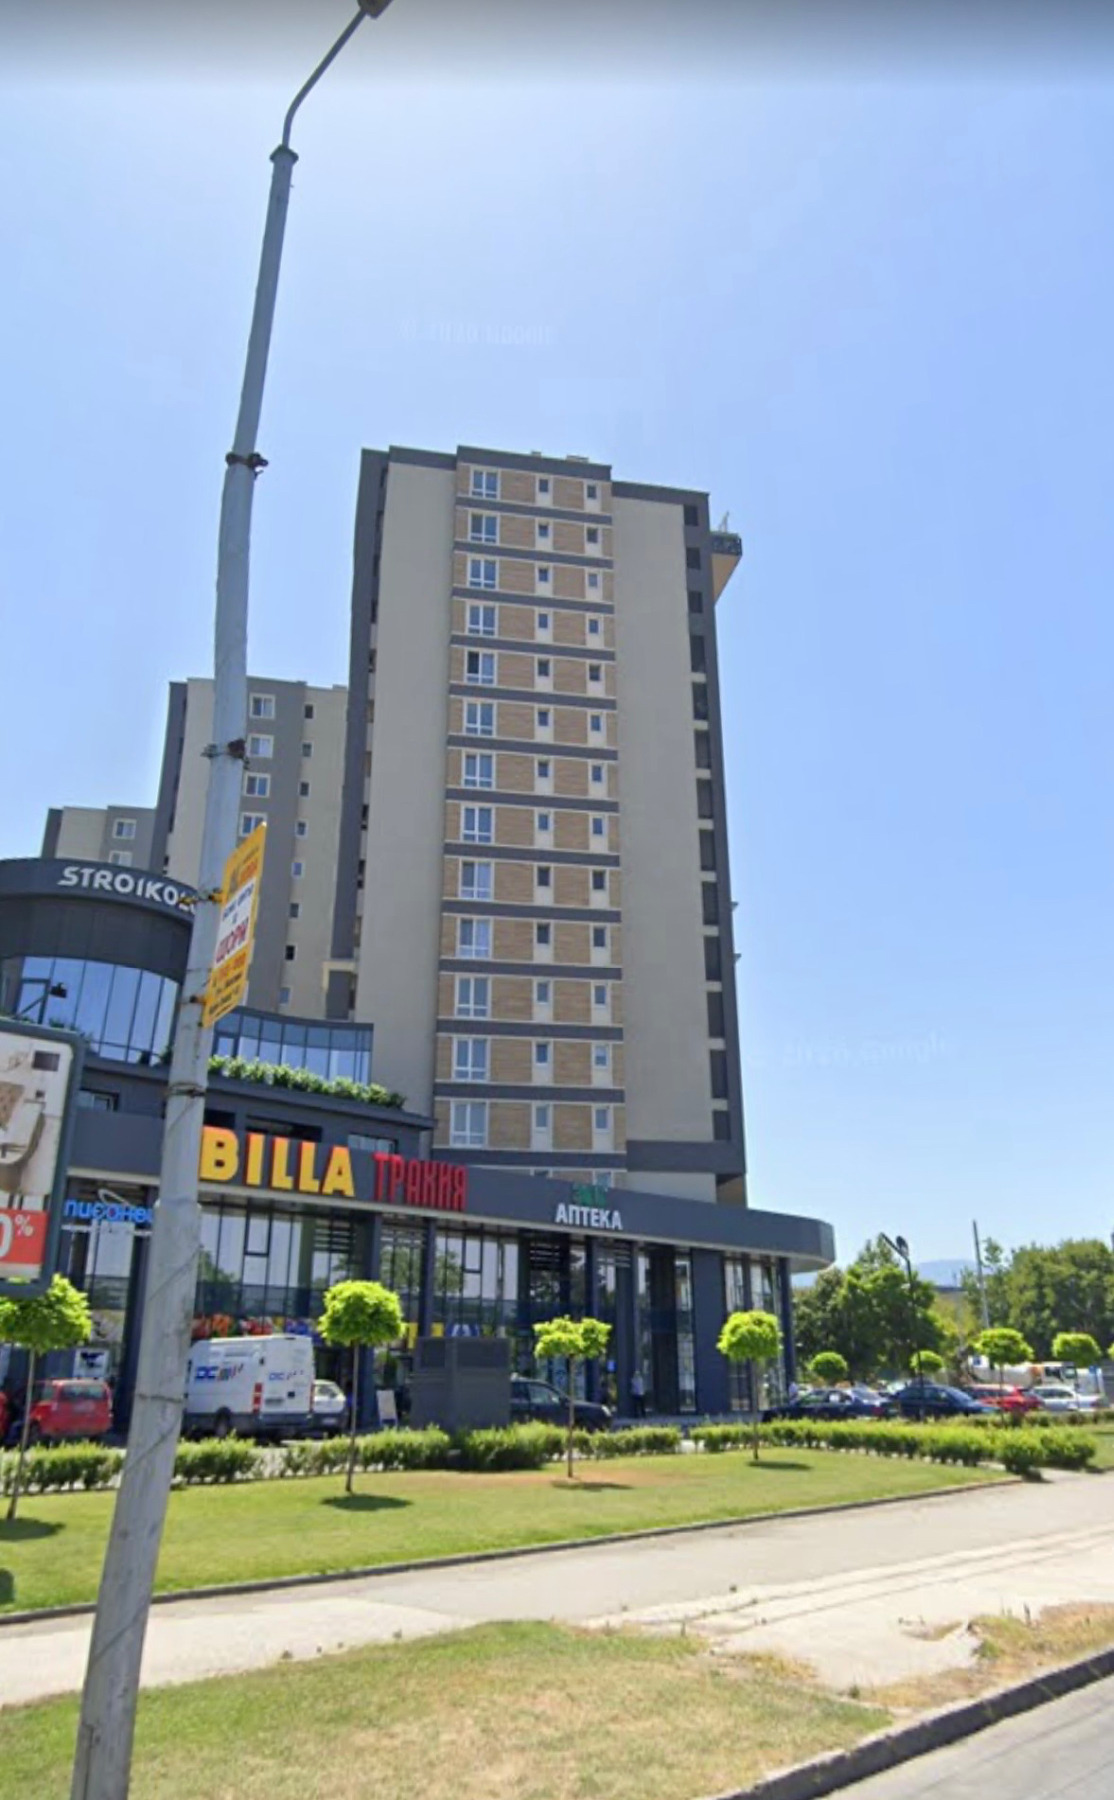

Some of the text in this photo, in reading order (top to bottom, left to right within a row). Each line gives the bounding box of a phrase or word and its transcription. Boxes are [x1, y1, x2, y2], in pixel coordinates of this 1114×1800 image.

[200, 1126, 467, 1210] BILLA ТРАКИЯ
[555, 1203, 623, 1230] АПТЕКА
